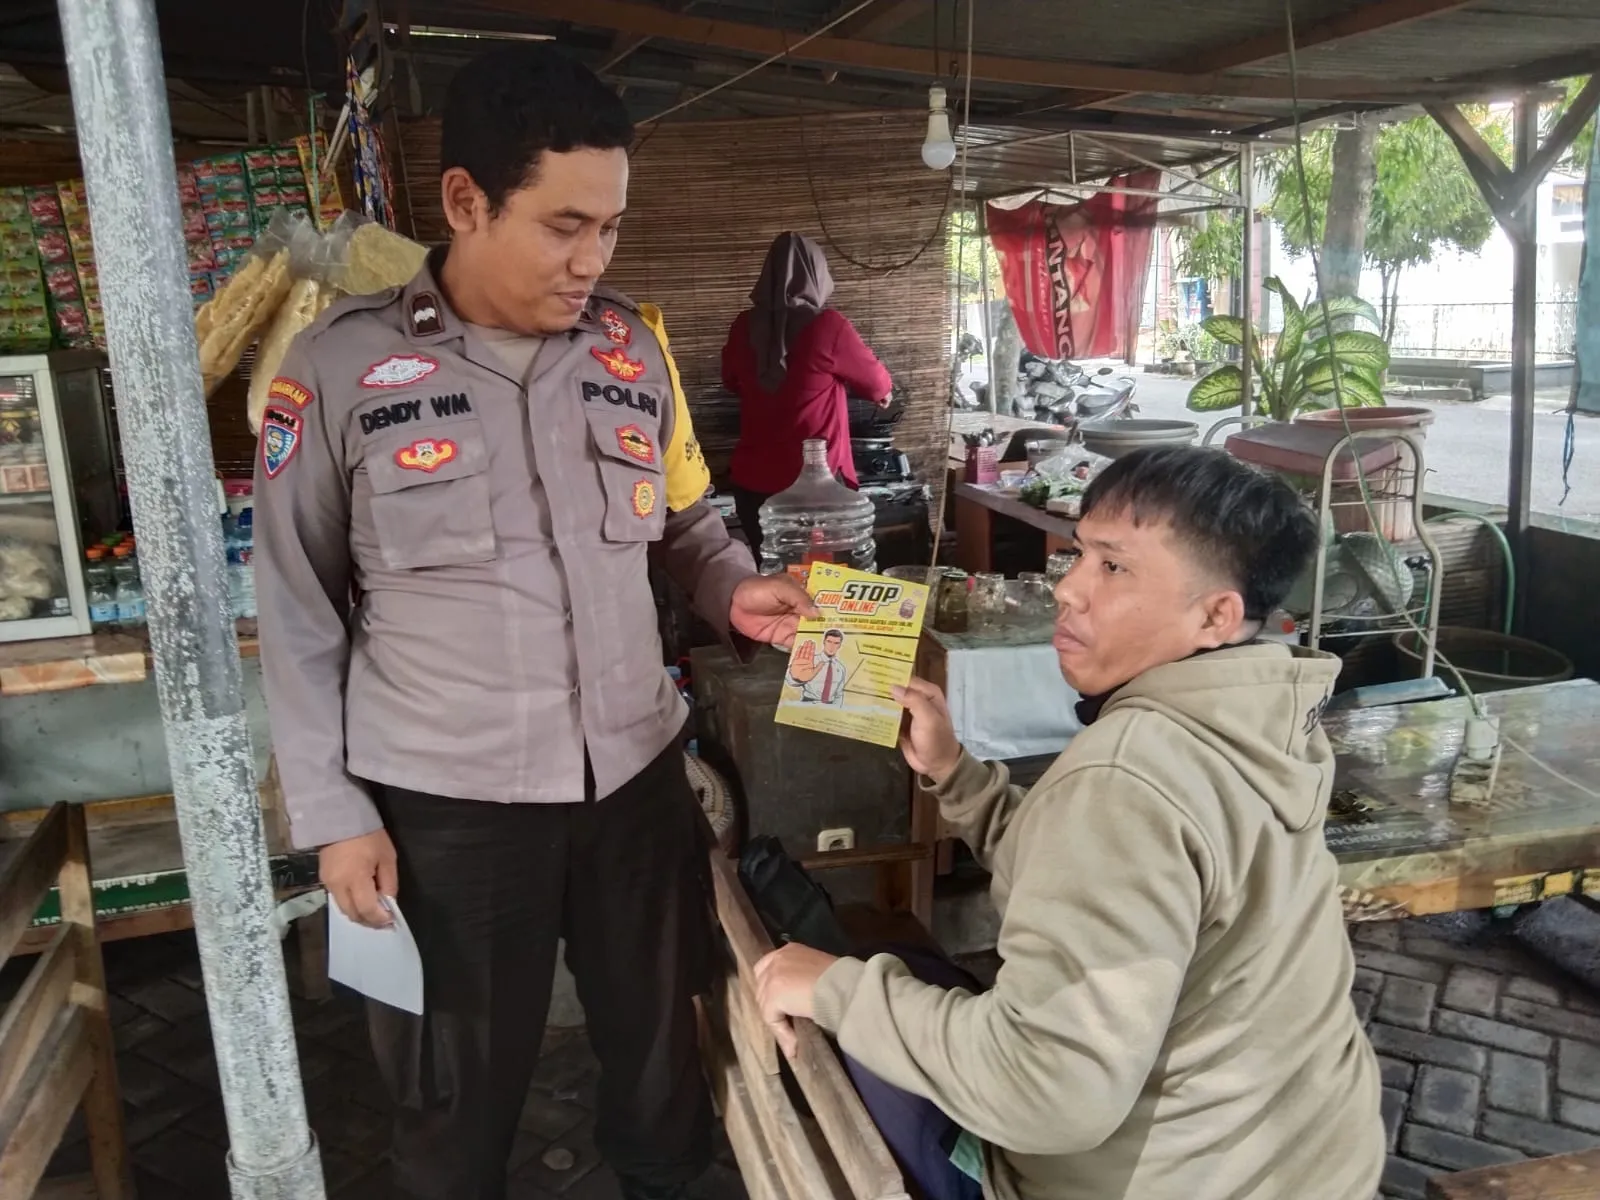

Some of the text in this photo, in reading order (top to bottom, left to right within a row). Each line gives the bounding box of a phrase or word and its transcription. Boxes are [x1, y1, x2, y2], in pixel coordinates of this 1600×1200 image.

[582, 382, 657, 417] POLRI
[359, 393, 472, 435] DENDY WM
[818, 593, 841, 605] JUDI
[844, 584, 899, 602] STOP
[840, 600, 876, 613] ONLINE
